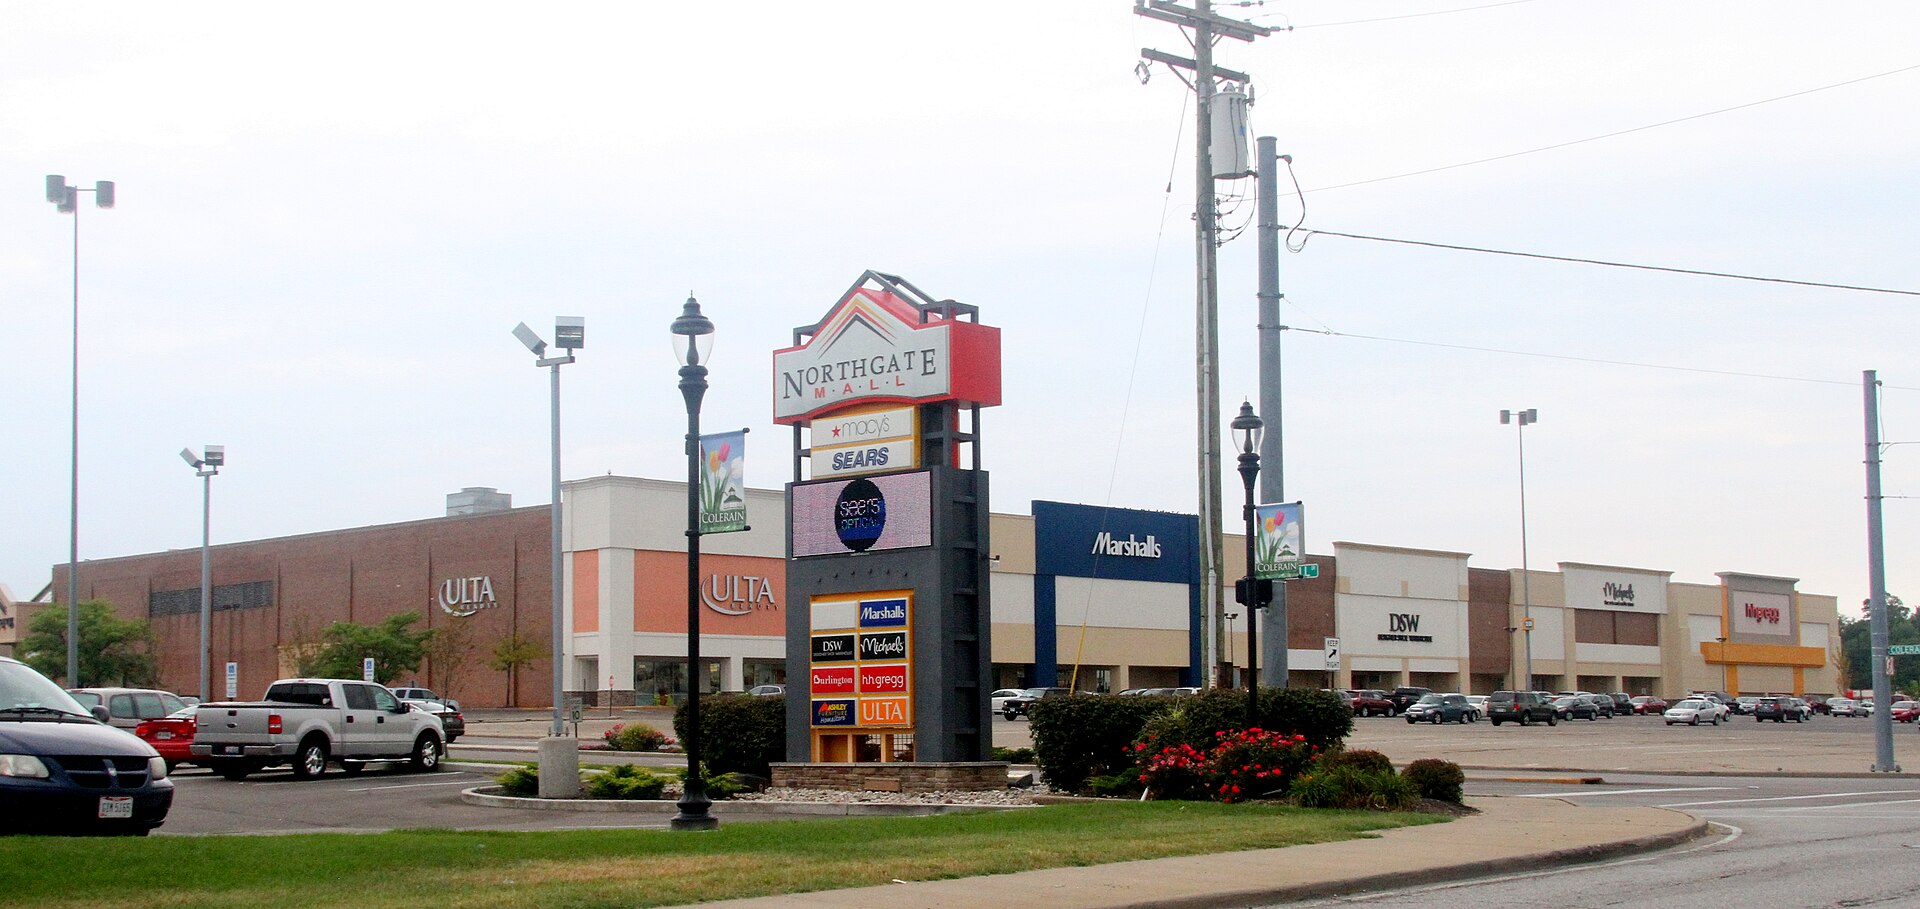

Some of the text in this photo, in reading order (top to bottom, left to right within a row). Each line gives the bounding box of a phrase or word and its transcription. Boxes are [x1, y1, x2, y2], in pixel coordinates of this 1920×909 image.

[783, 348, 936, 399] NORTHGATE
[841, 414, 890, 438] macy's
[832, 447, 889, 471] SEARS
[702, 510, 744, 524] COLERAIN
[1091, 531, 1162, 558] Marshalls
[1257, 561, 1297, 573] COLERAIN
[446, 575, 496, 605] ULTA
[711, 574, 775, 604] ULTA
[861, 606, 905, 620] Marshalls
[1389, 613, 1421, 632] DSW
[823, 640, 843, 652] DSW
[860, 636, 904, 655] Michaels
[813, 674, 853, 686] Burlington
[862, 674, 904, 689] hhgregg
[572, 710, 580, 720] 10
[863, 702, 903, 721] ULTA
